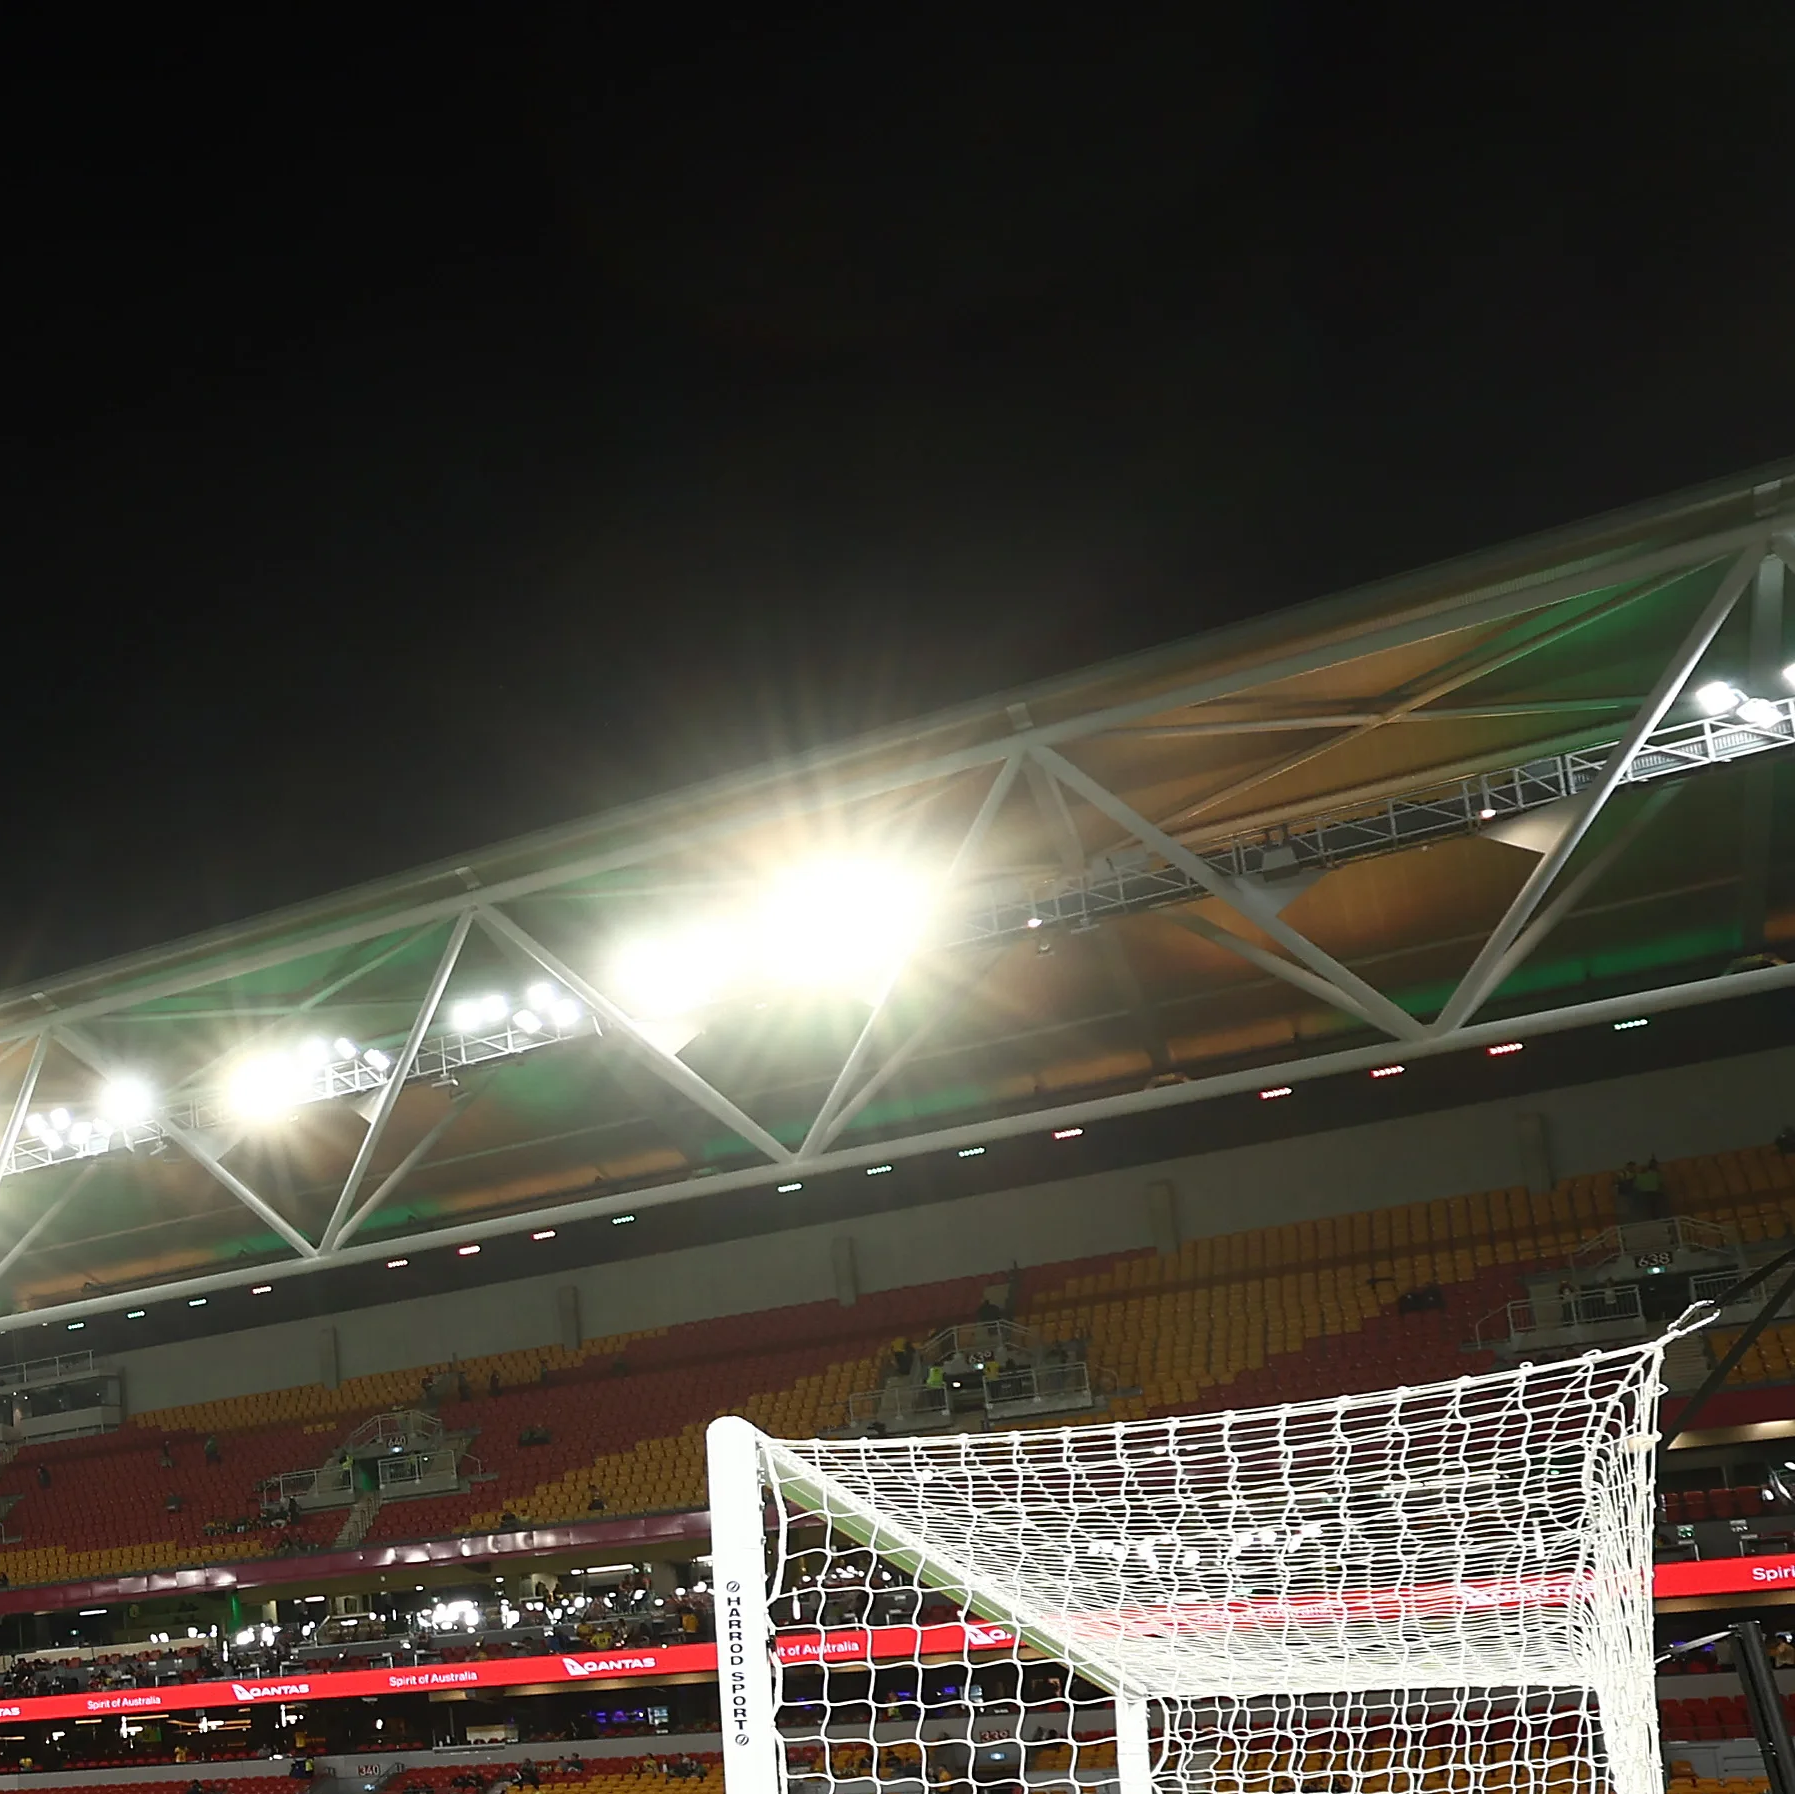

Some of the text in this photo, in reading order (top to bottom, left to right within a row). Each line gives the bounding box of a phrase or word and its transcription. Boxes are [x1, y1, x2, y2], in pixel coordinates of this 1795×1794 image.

[1752, 1565, 1795, 1581] Spiri
[787, 1645, 800, 1656] of
[802, 1641, 860, 1655] Autralia
[583, 1657, 656, 1671] QANTAS
[727, 1597, 748, 1730] HARROD SPORT
[389, 1671, 478, 1687] Spirit of Australia
[250, 1684, 310, 1698] QANTAS
[87, 1699, 110, 1711] Spirit
[121, 1696, 161, 1709] Australia
[358, 1764, 380, 1777] 340
